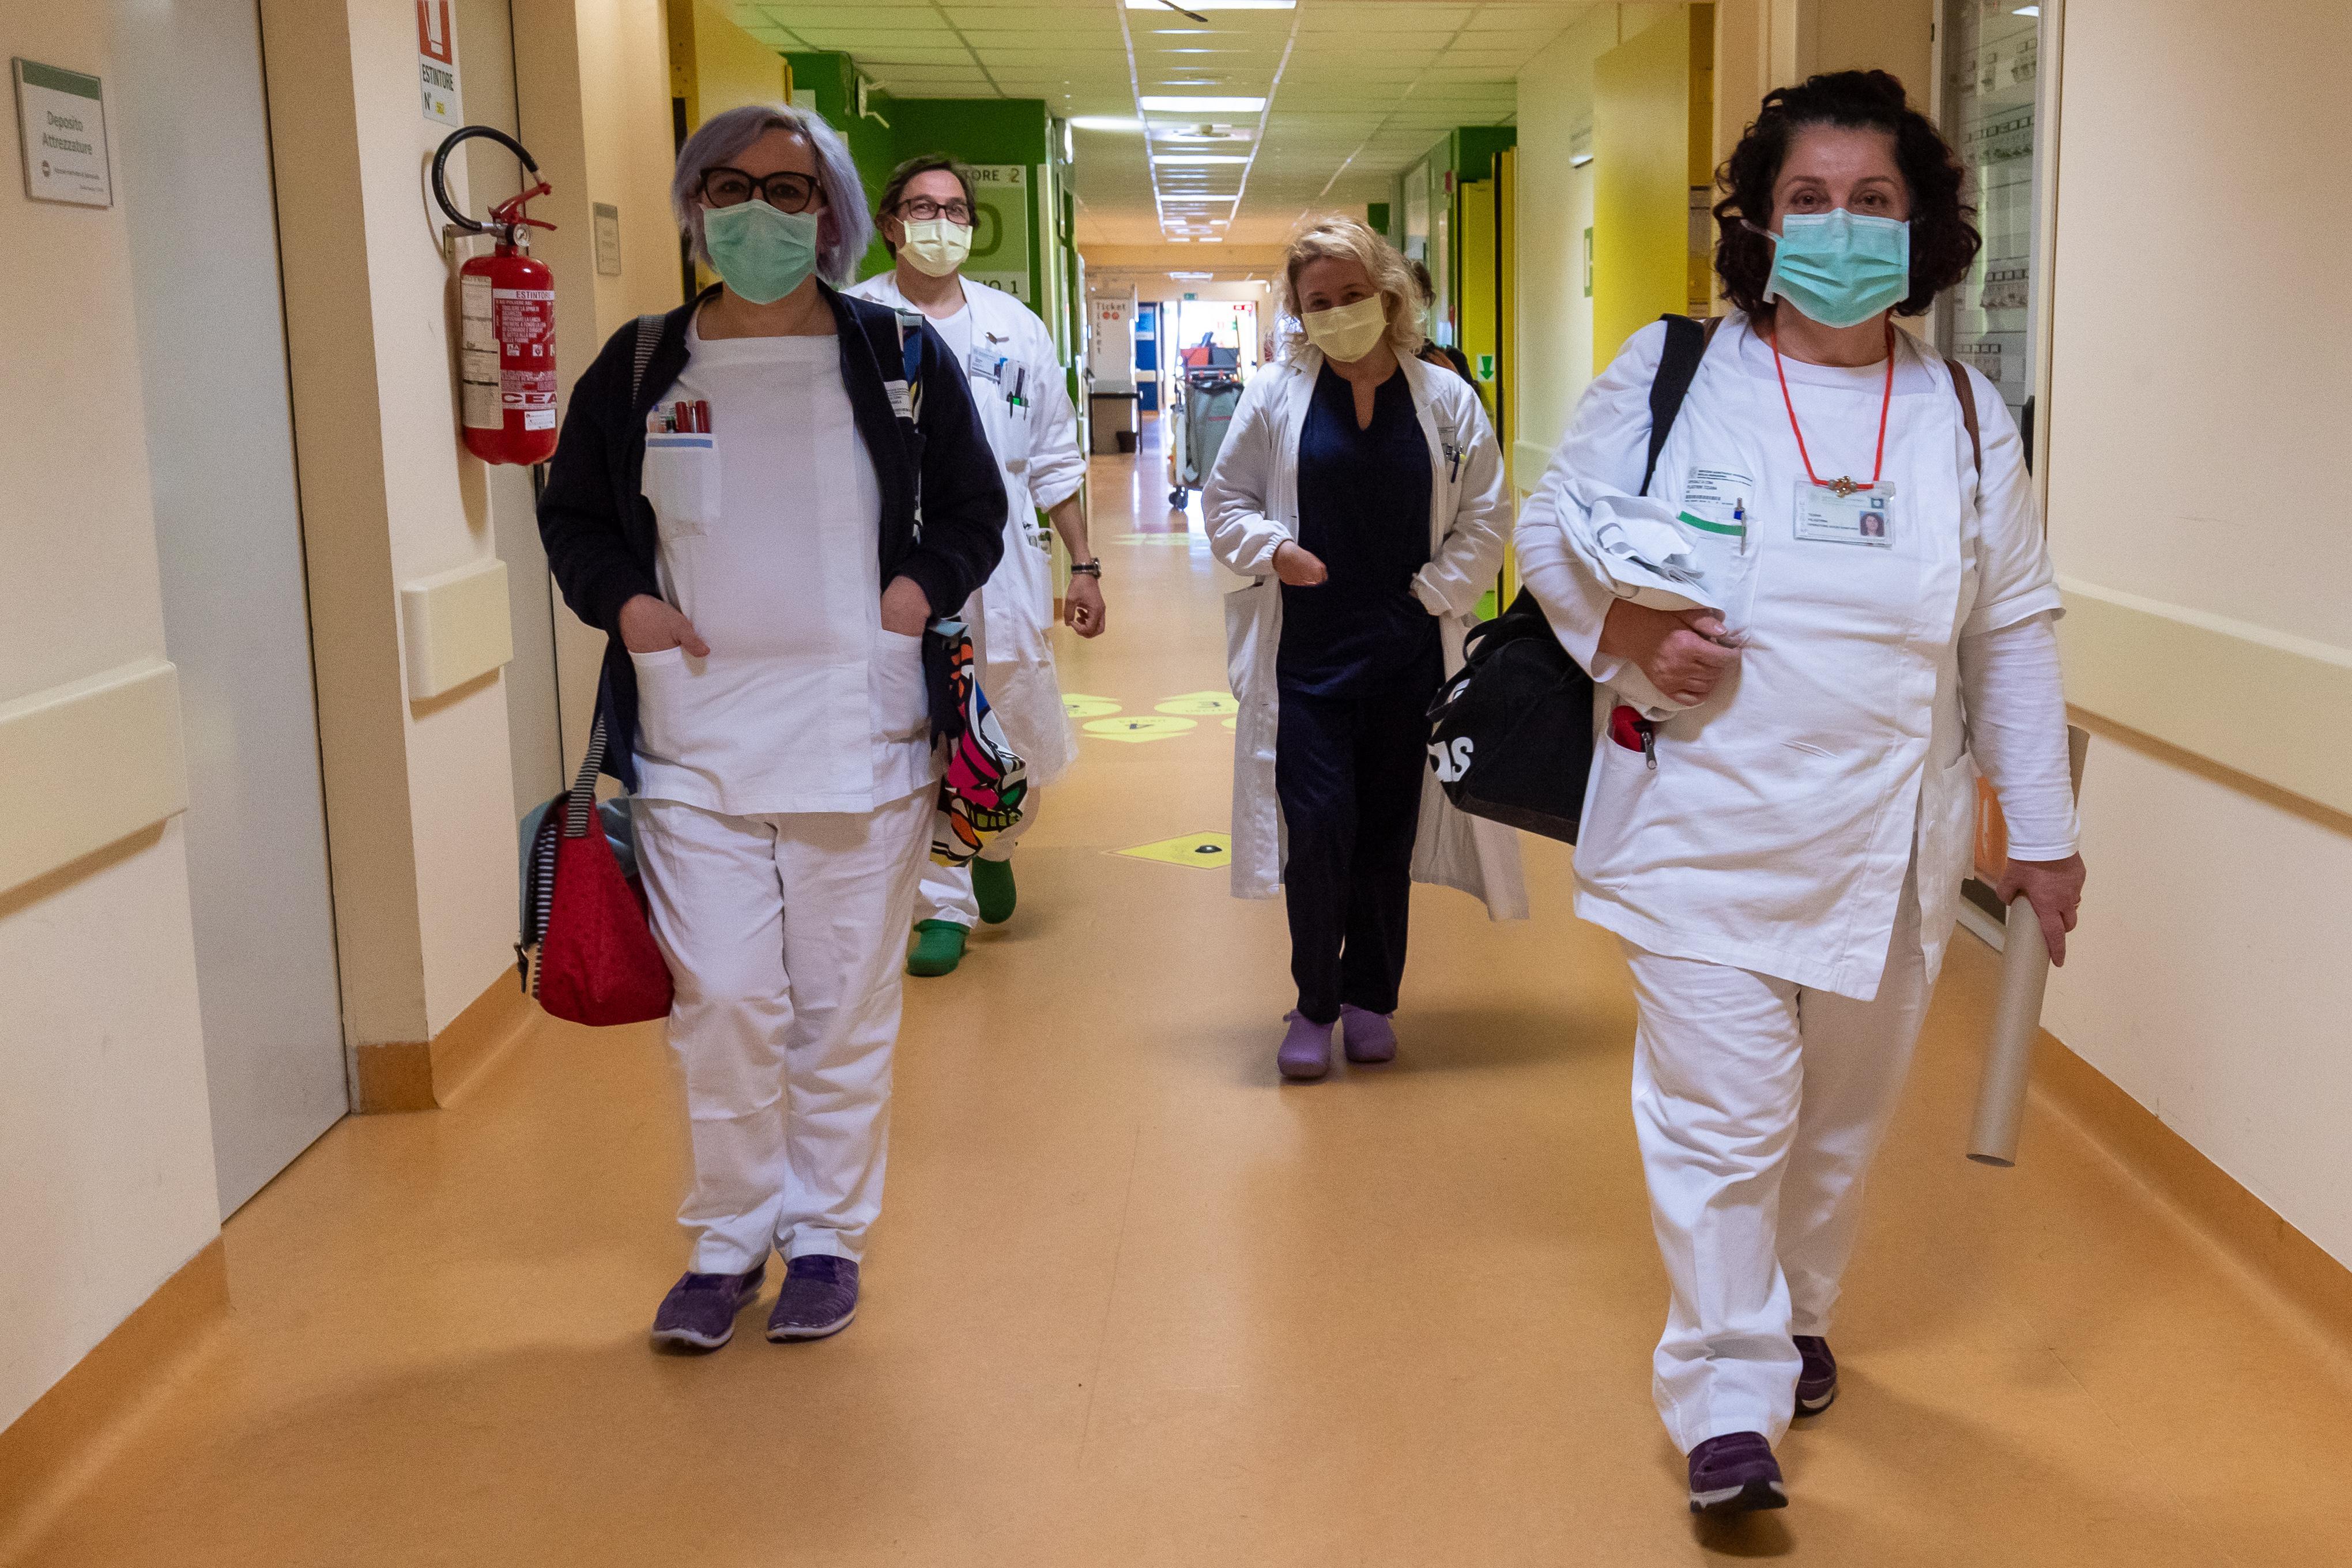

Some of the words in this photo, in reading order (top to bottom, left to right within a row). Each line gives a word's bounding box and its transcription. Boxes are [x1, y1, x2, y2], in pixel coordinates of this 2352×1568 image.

[422, 63, 454, 91] ESTINTORE
[47, 110, 84, 132] Deposito
[1009, 167, 1020, 183] 2
[1010, 280, 1018, 294] 1
[1096, 302, 1126, 311] Ticket
